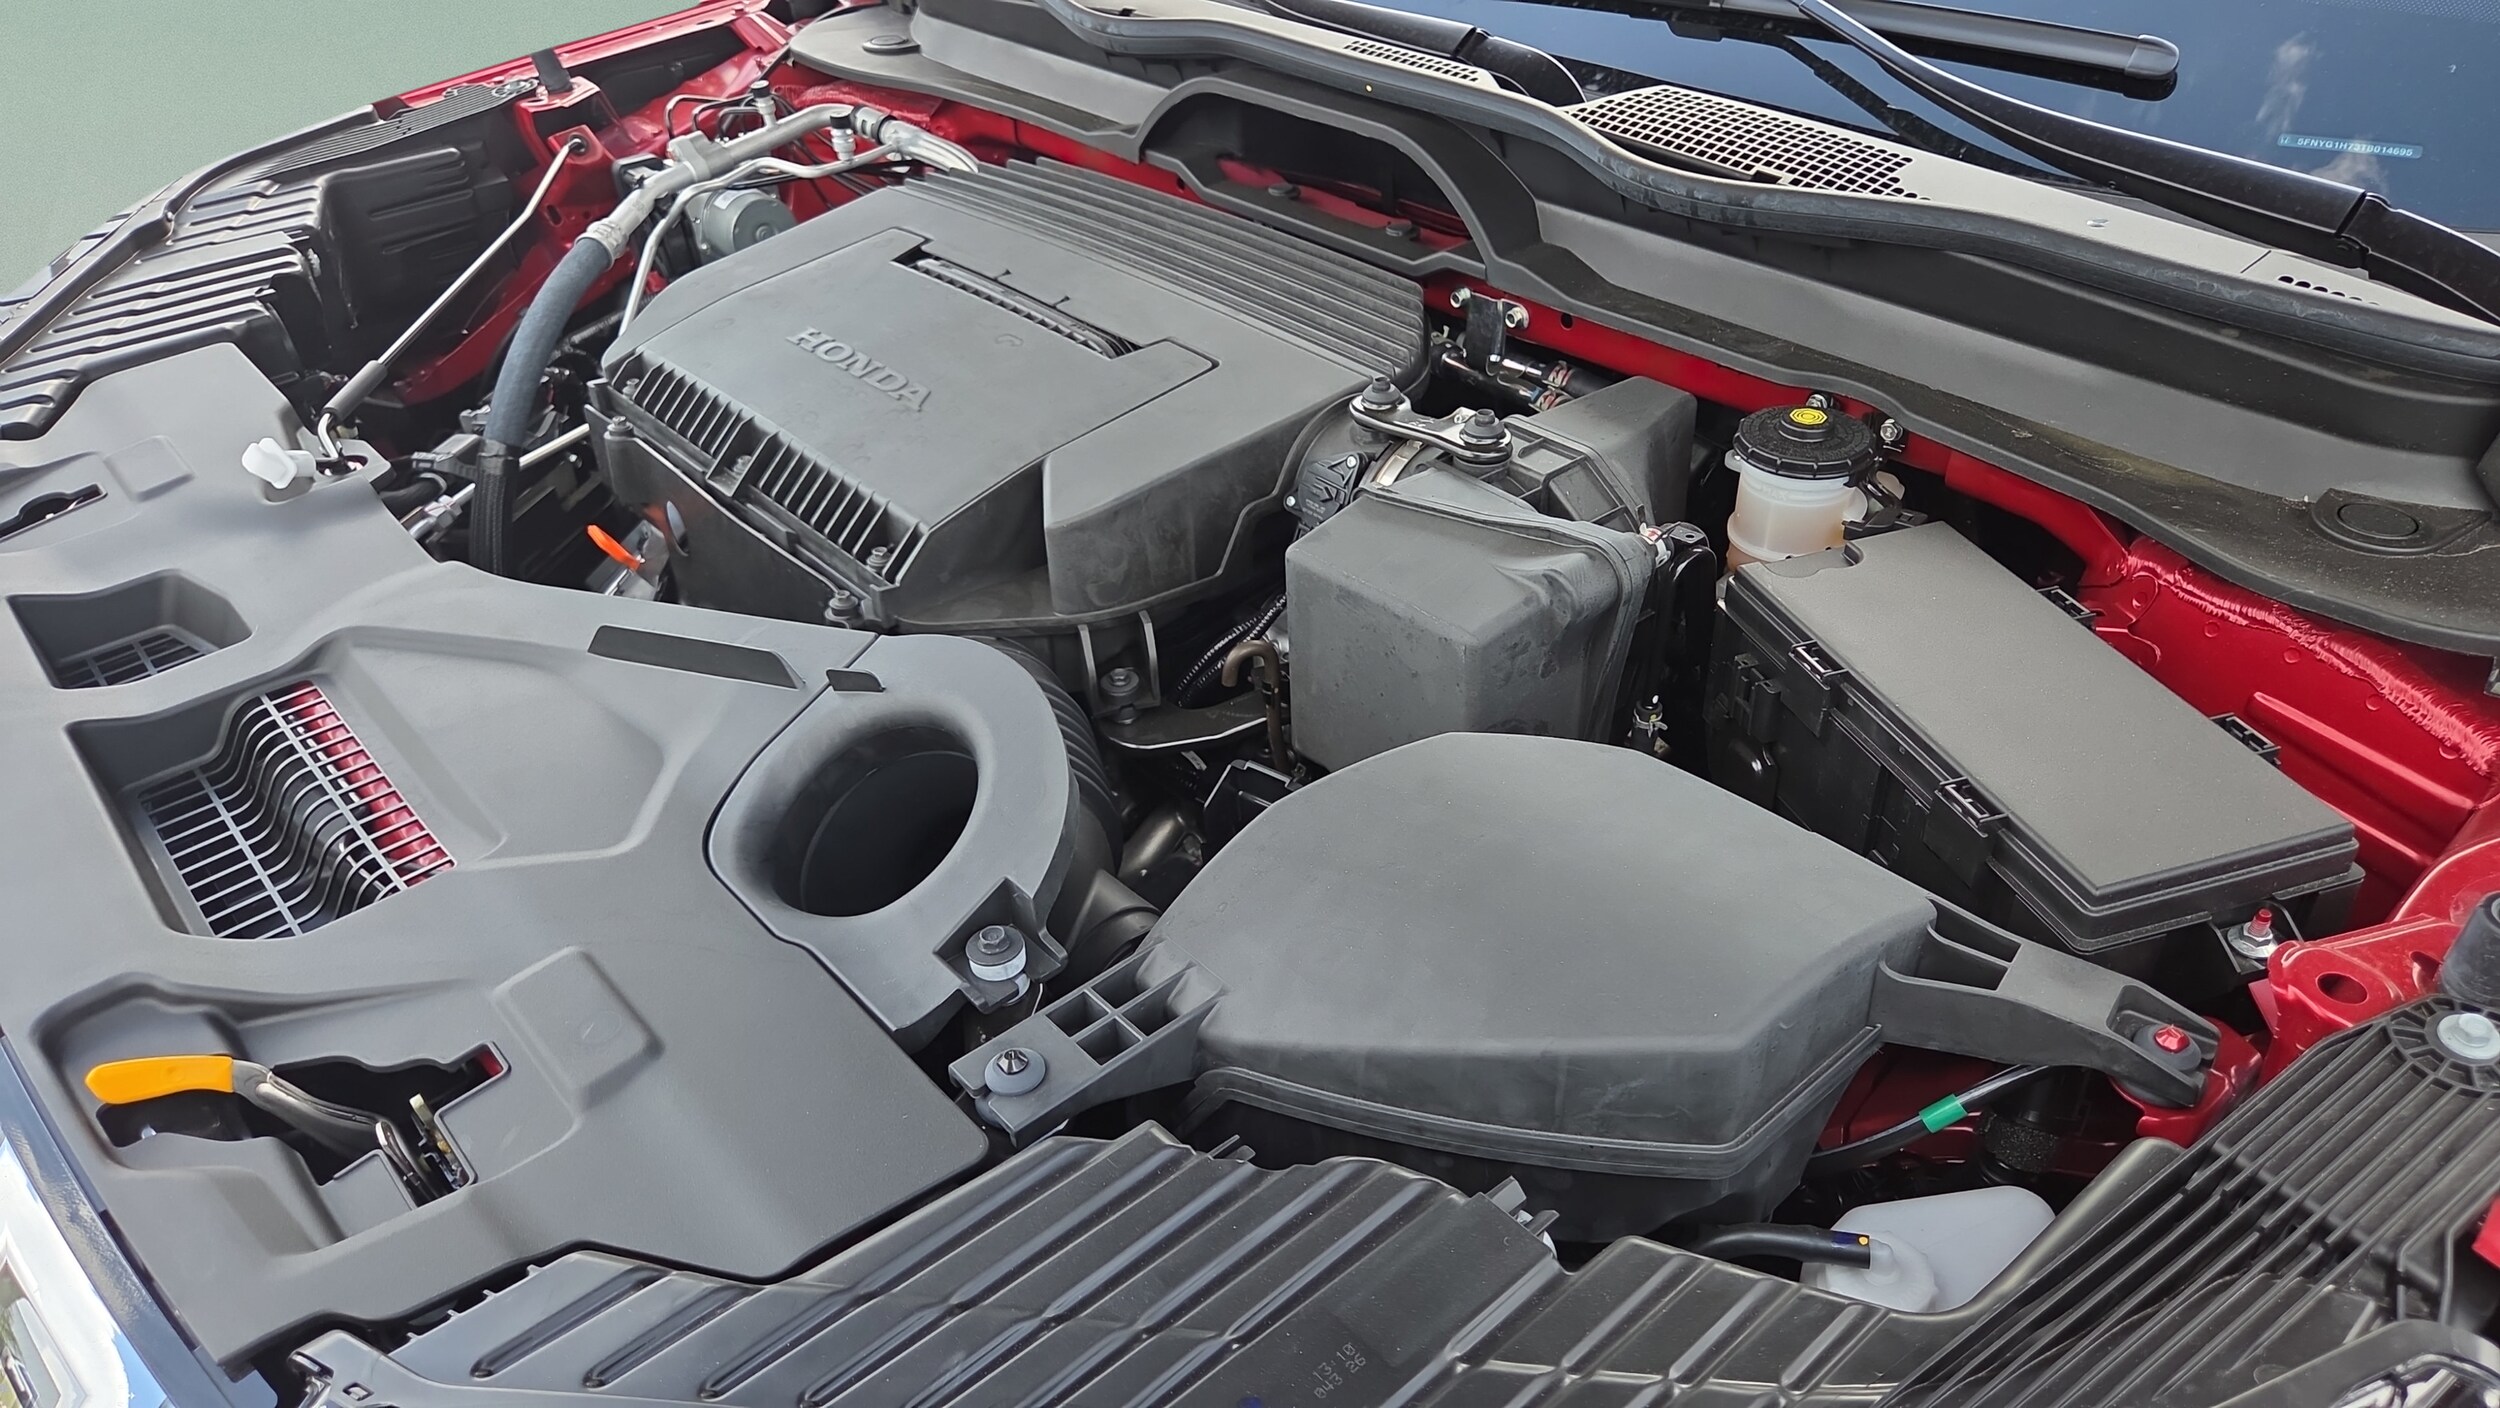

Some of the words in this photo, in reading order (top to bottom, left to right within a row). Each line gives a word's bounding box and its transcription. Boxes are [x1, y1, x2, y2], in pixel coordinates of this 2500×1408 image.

[785, 326, 931, 412] HONDA
[1313, 1372, 1343, 1399] 043
[1345, 1352, 1366, 1374] 26
